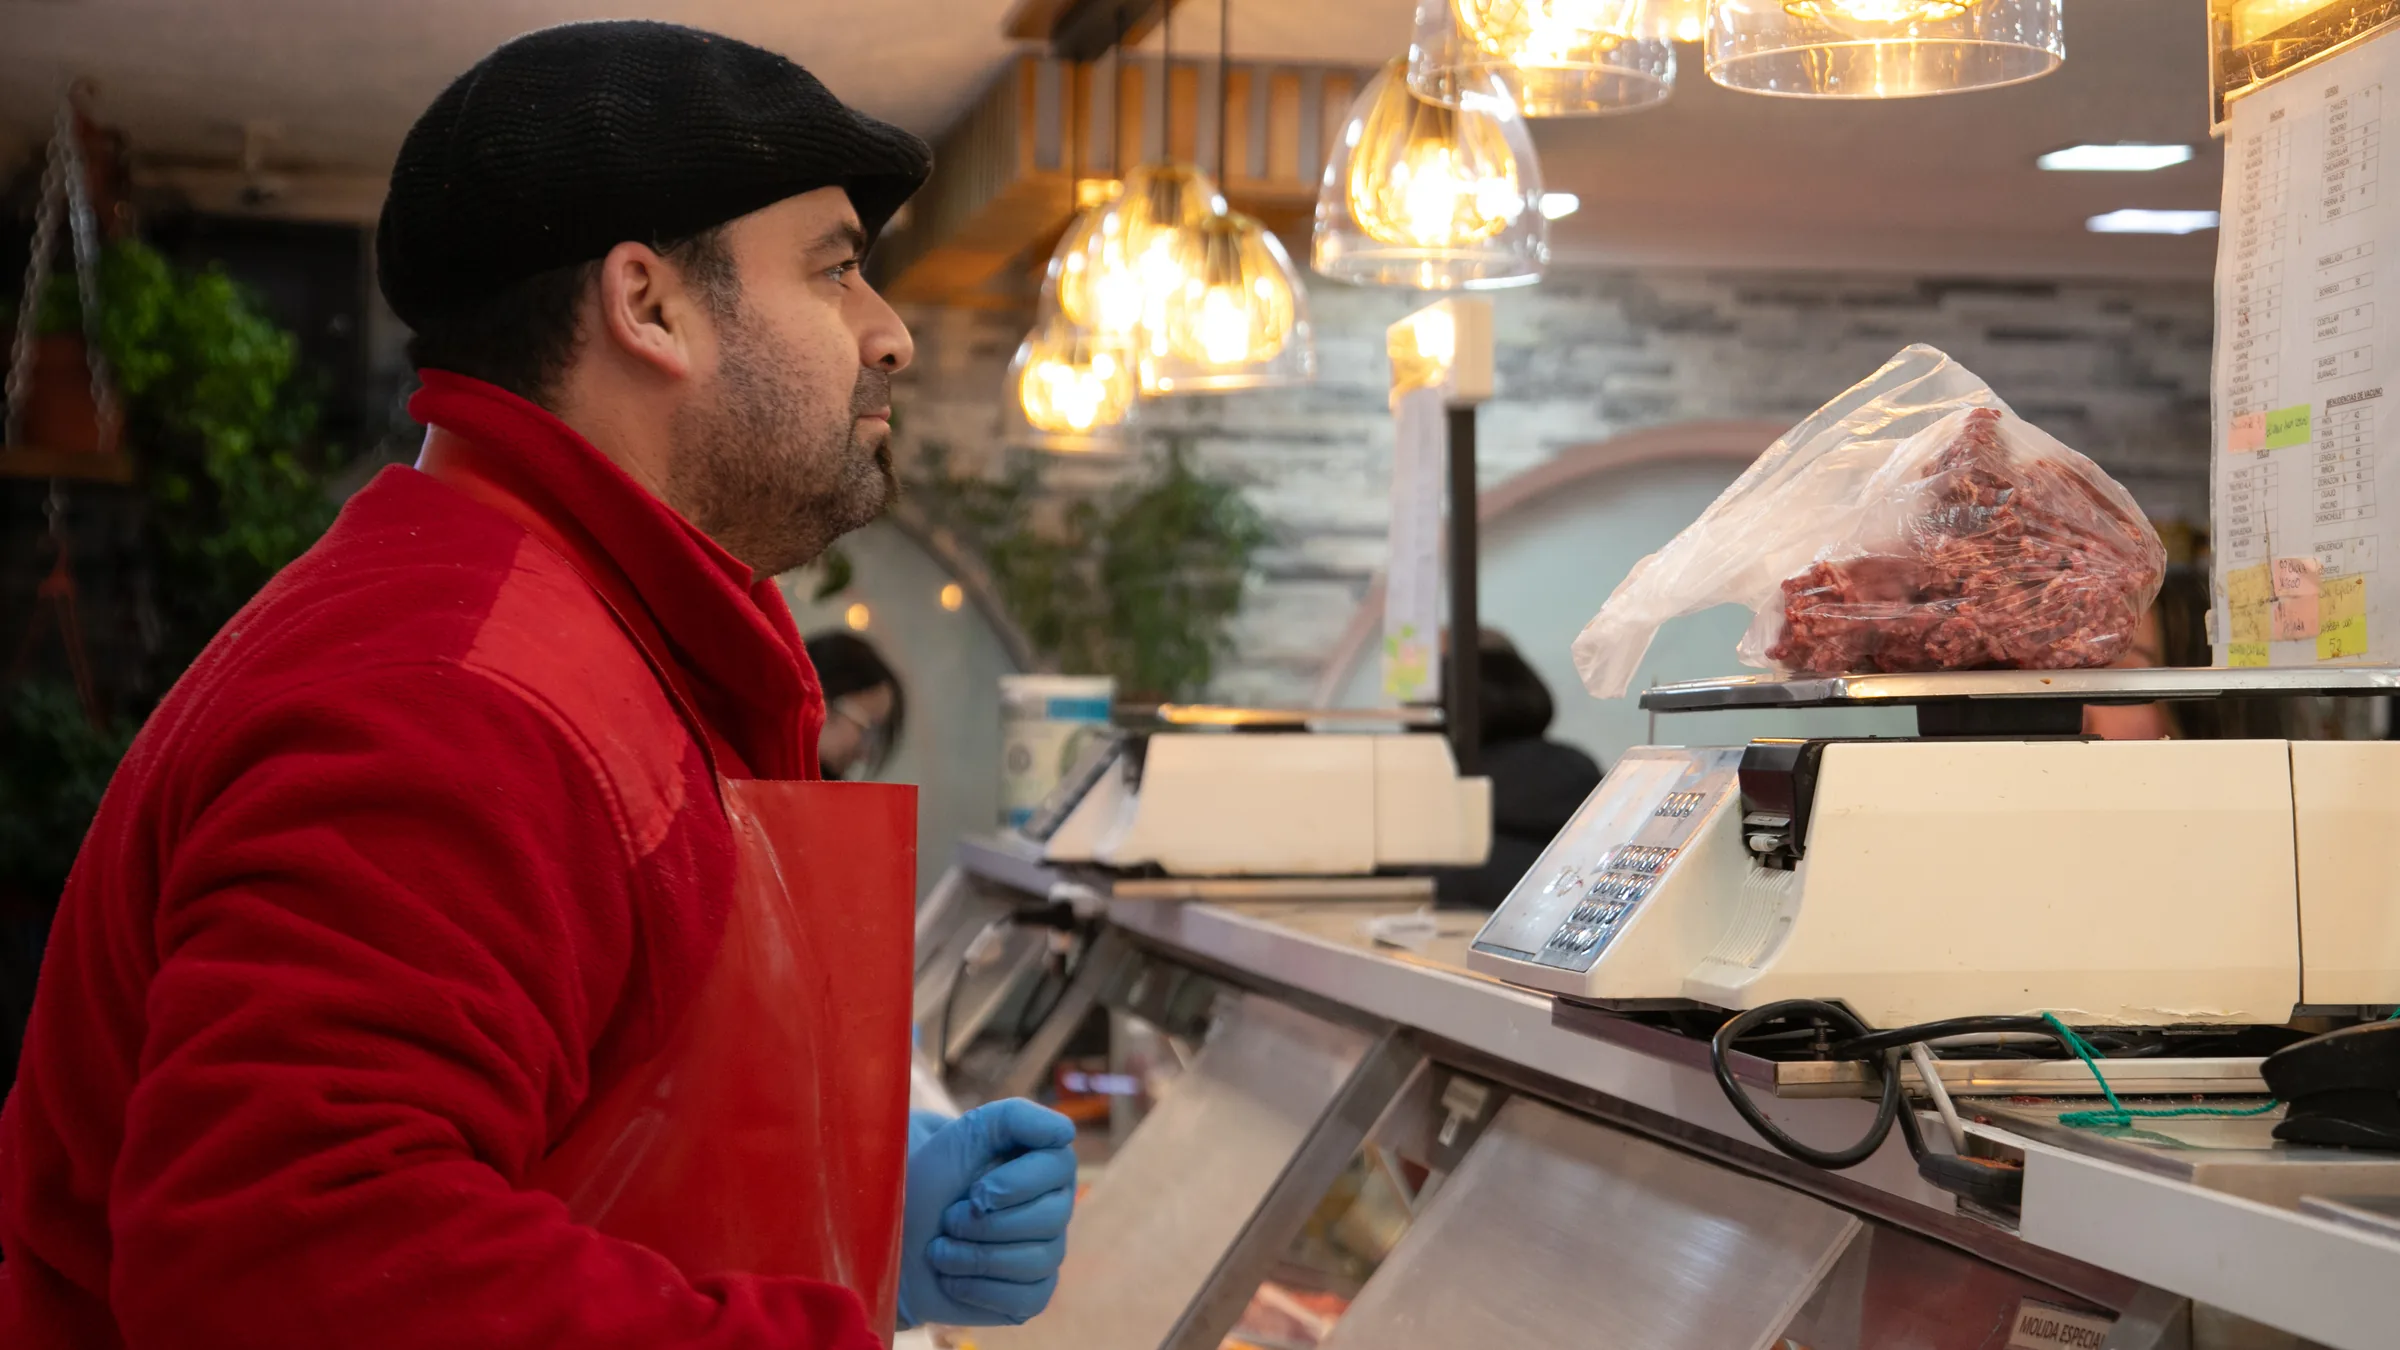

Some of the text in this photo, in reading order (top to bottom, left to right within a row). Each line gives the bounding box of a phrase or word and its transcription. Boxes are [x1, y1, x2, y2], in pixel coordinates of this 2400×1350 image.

[2364, 387, 2383, 400] VACUNO
[2315, 542, 2343, 552] MENUDENCIA
[2325, 555, 2332, 563] DE
[2329, 637, 2342, 654] 52
[2020, 1315, 2060, 1341] MOLIDA
